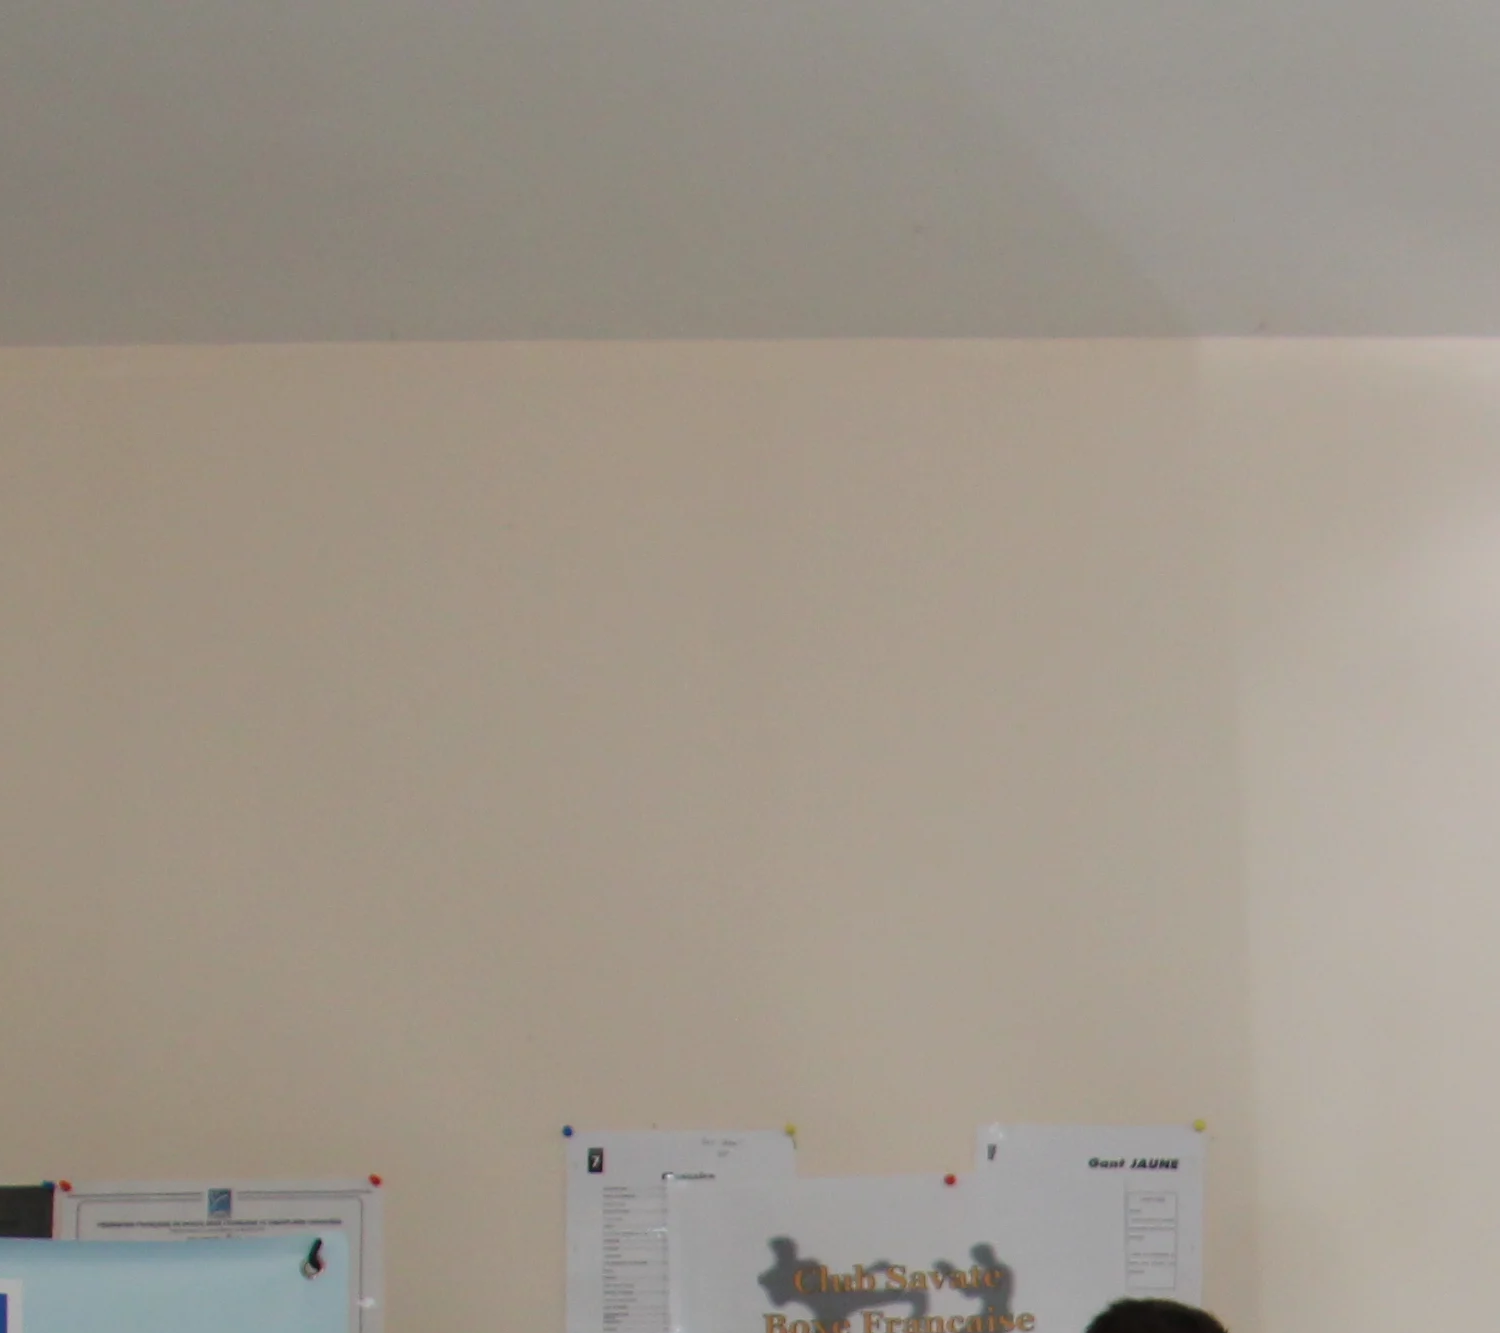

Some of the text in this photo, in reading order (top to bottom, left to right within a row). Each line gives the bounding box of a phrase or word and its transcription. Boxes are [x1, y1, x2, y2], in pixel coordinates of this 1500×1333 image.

[1130, 1157, 1180, 1169] JAUNE
[793, 1264, 1003, 1294] Club Savate
